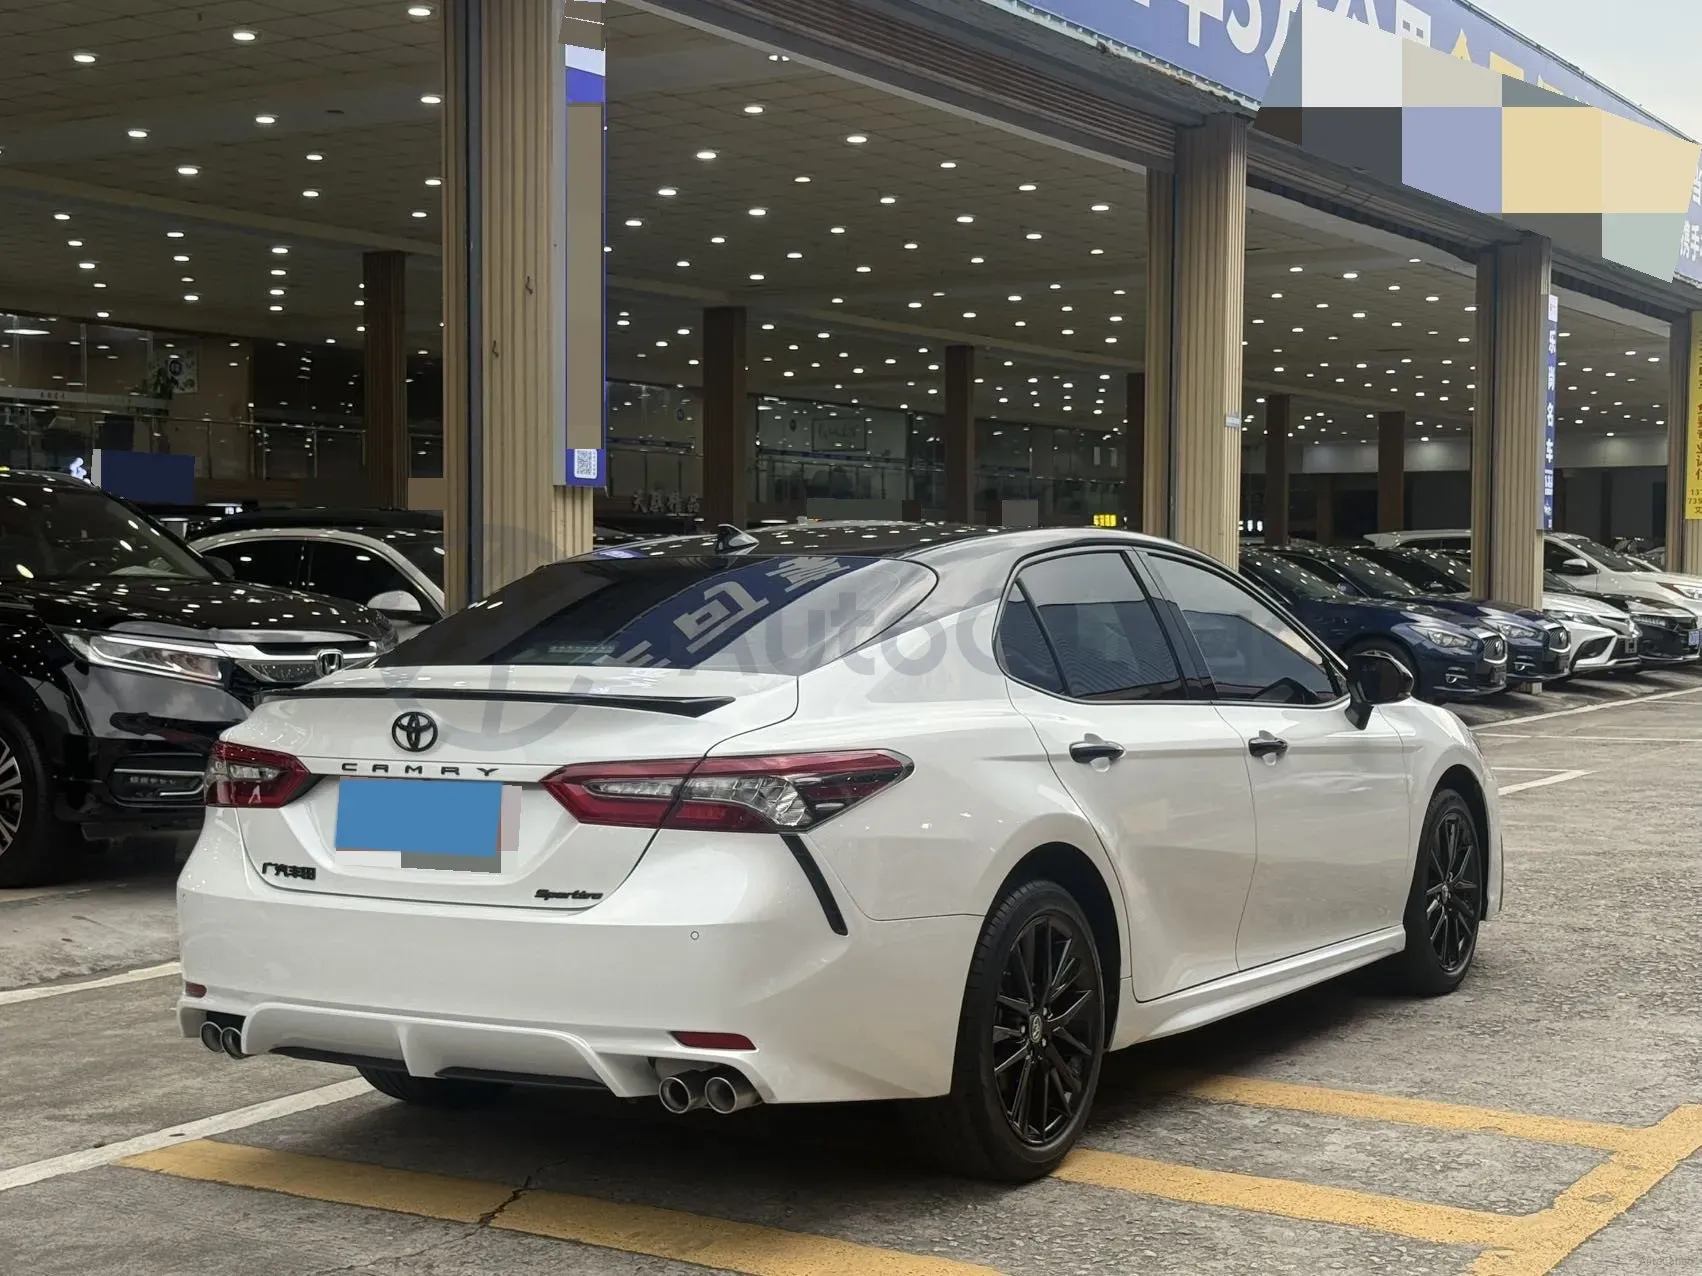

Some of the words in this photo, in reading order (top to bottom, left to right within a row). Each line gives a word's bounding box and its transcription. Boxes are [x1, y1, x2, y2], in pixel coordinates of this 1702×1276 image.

[341, 762, 499, 777] CAMRY
[262, 862, 316, 881] 广汽丰田
